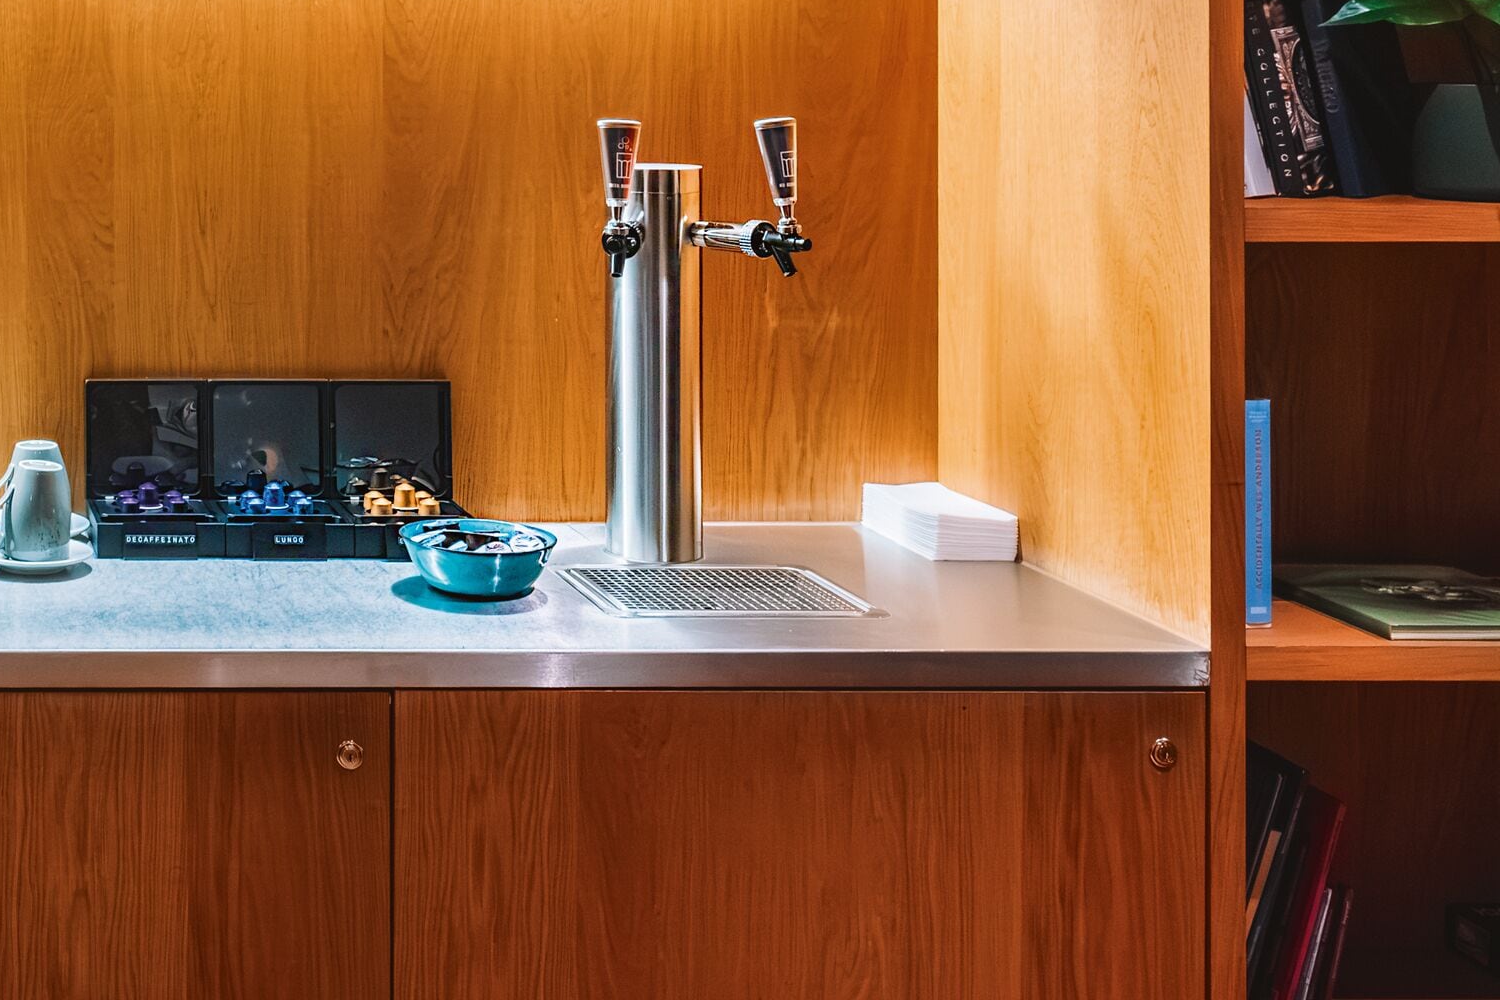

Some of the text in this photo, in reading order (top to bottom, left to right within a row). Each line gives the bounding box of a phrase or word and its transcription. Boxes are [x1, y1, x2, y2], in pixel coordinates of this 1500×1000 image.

[1257, 47, 1292, 178] COLLECTION
[125, 536, 196, 544] DECAFFEINATO
[274, 535, 304, 544] LUNGO
